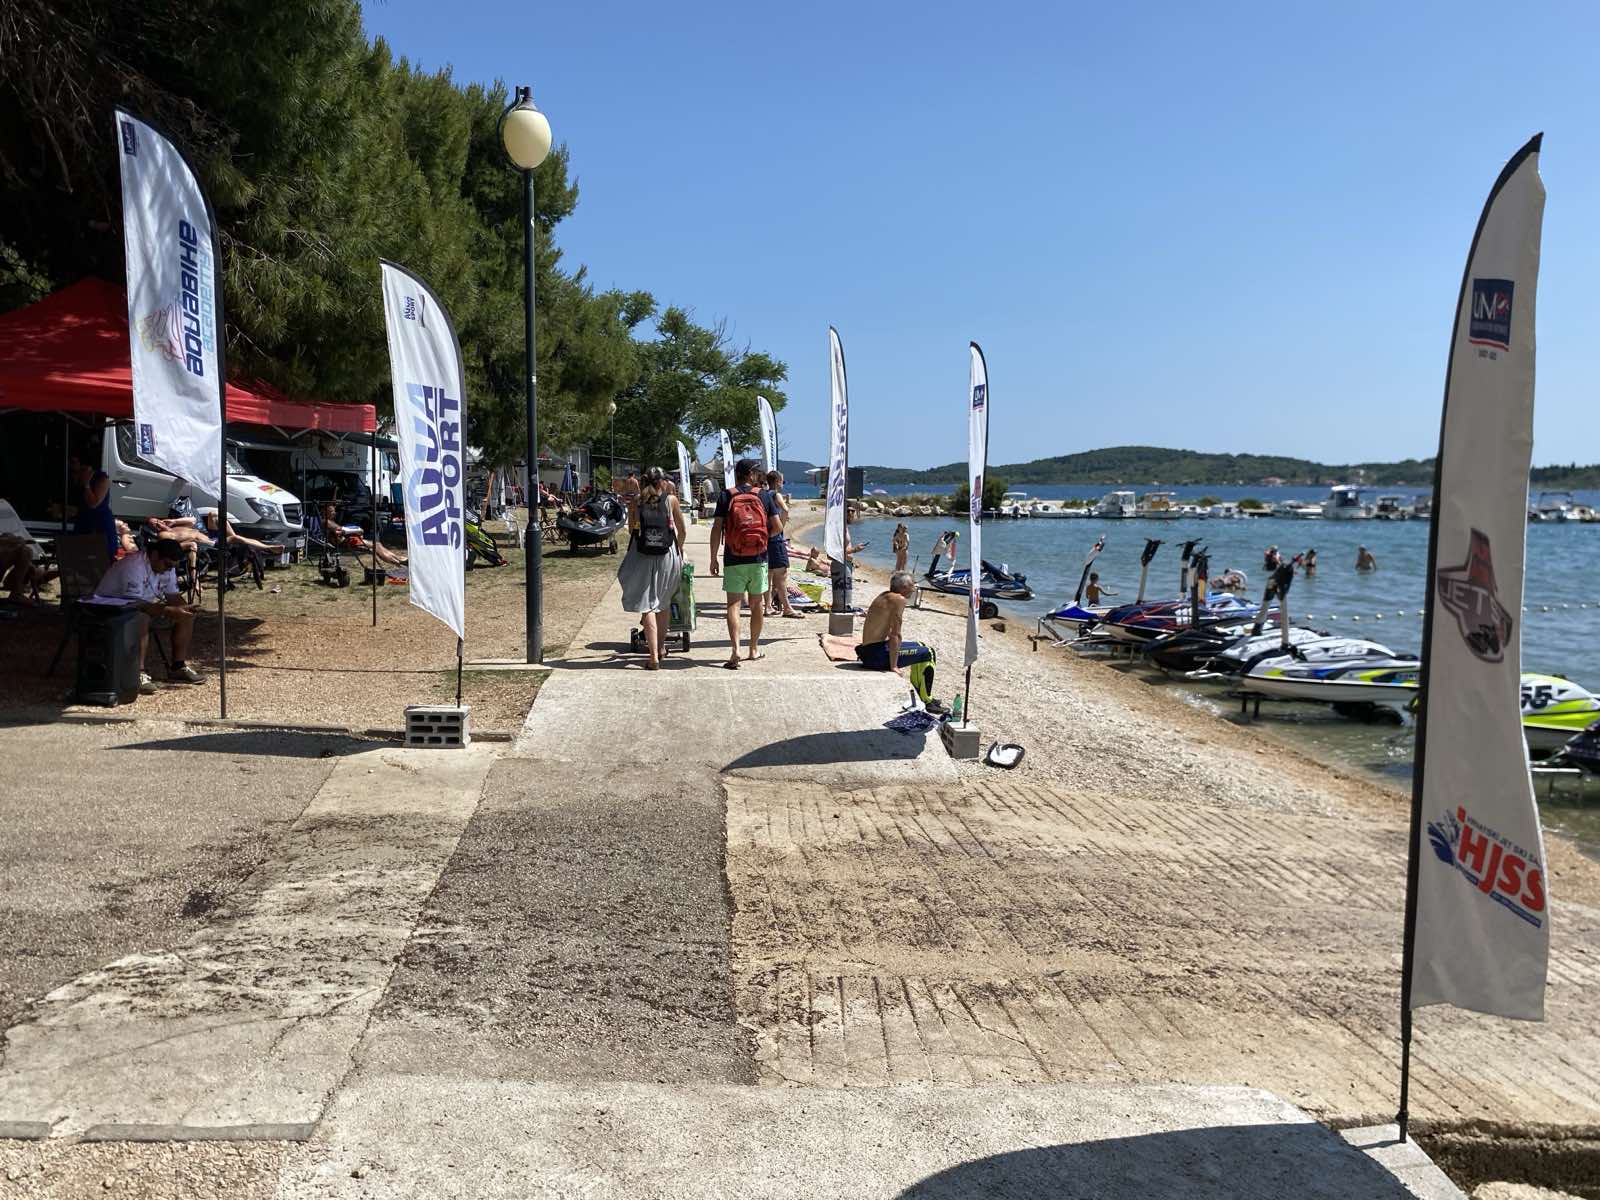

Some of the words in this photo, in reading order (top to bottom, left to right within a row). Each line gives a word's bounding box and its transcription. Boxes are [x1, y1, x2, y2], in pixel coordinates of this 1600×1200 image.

[406, 382, 449, 546] AQUA
[439, 387, 461, 550] SPORT
[1457, 823, 1545, 912] HJSS
